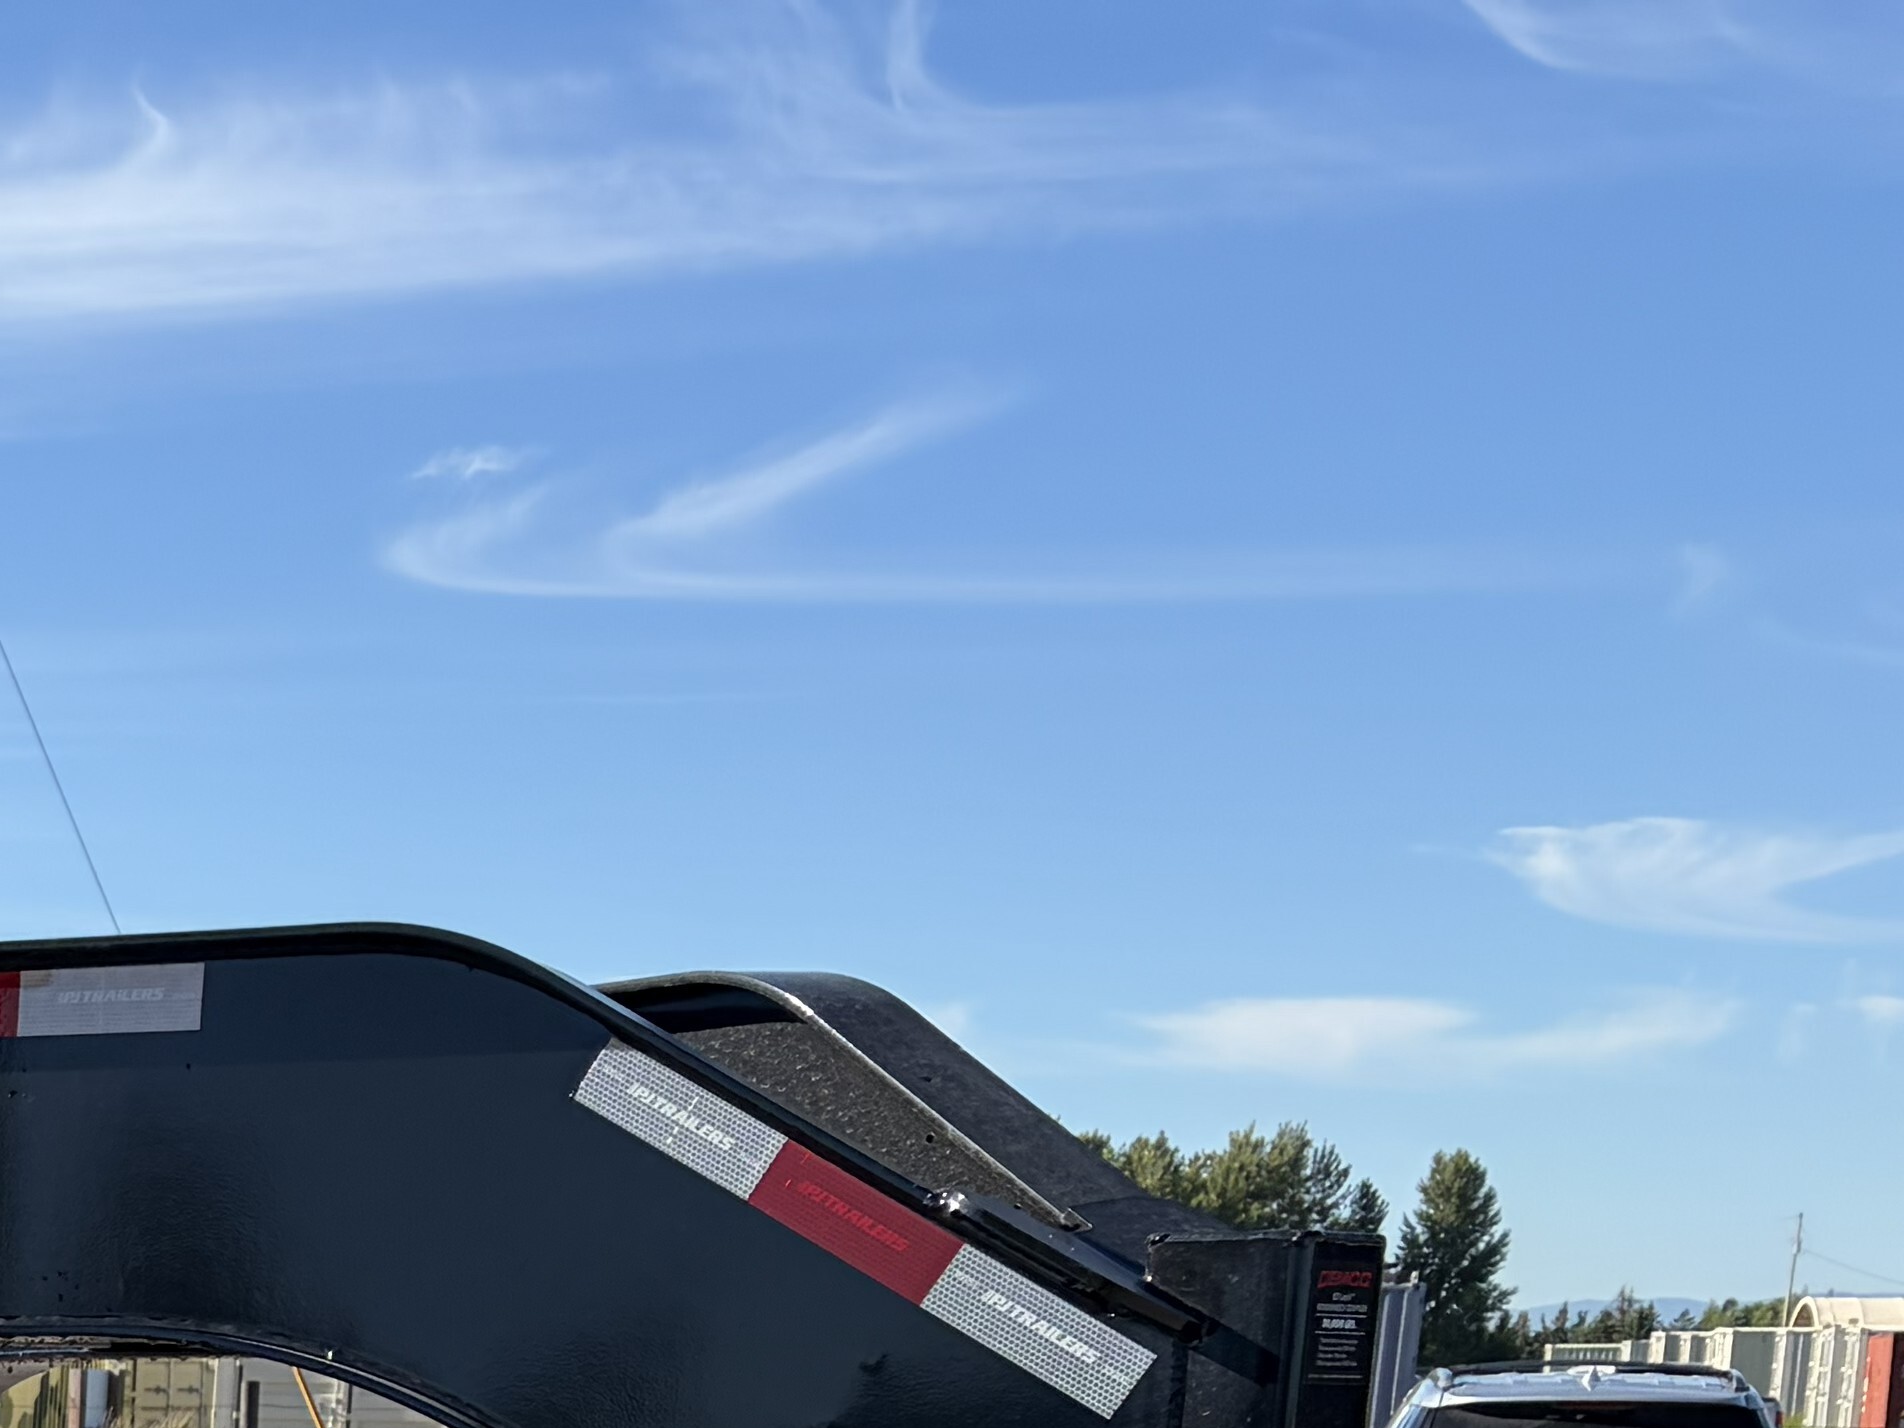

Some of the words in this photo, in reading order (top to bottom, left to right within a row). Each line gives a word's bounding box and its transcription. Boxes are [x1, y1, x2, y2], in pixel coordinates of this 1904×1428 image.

[83, 987, 165, 1002] TRAILERS
[652, 1096, 736, 1151] TRAILERS
[821, 1195, 910, 1253] TRAILERS
[1008, 1304, 1102, 1365] TRAILERS
